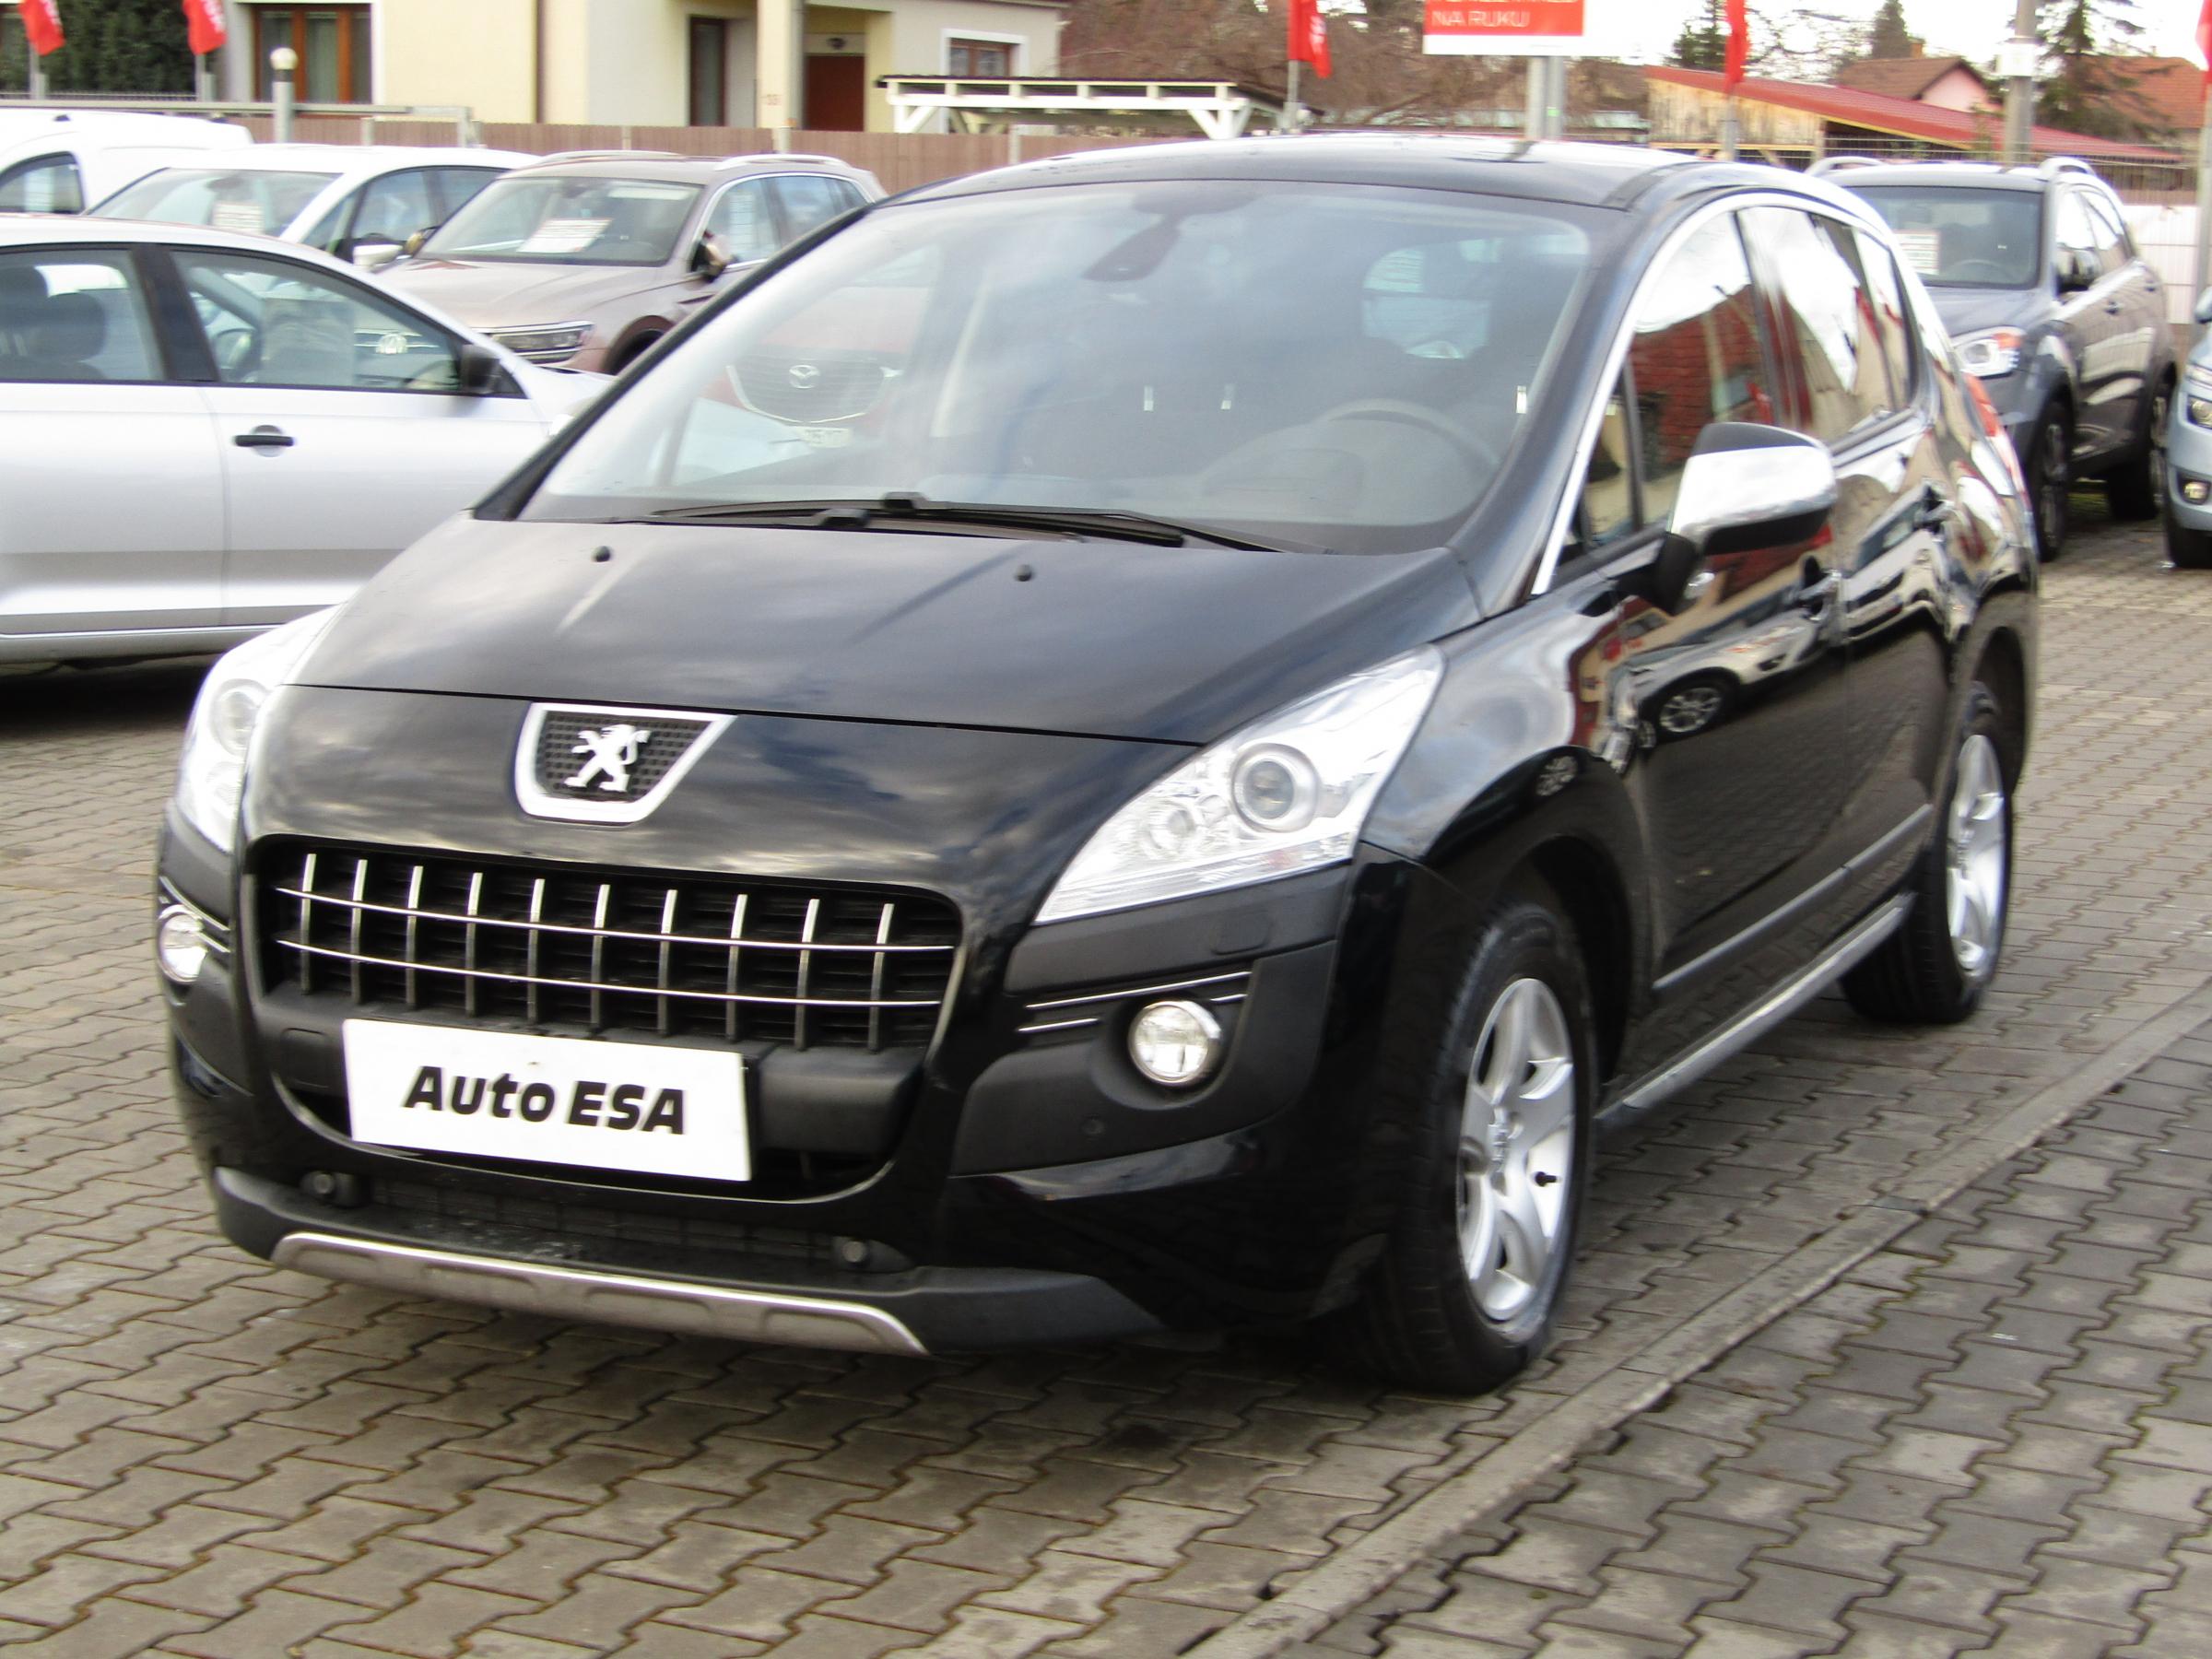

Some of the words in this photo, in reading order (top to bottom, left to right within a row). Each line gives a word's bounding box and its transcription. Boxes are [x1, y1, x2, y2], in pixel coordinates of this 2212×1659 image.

[1431, 10, 1466, 26] NA
[1468, 11, 1530, 27] RUKU
[403, 1065, 555, 1123] Auto
[565, 1080, 685, 1135] ESA
